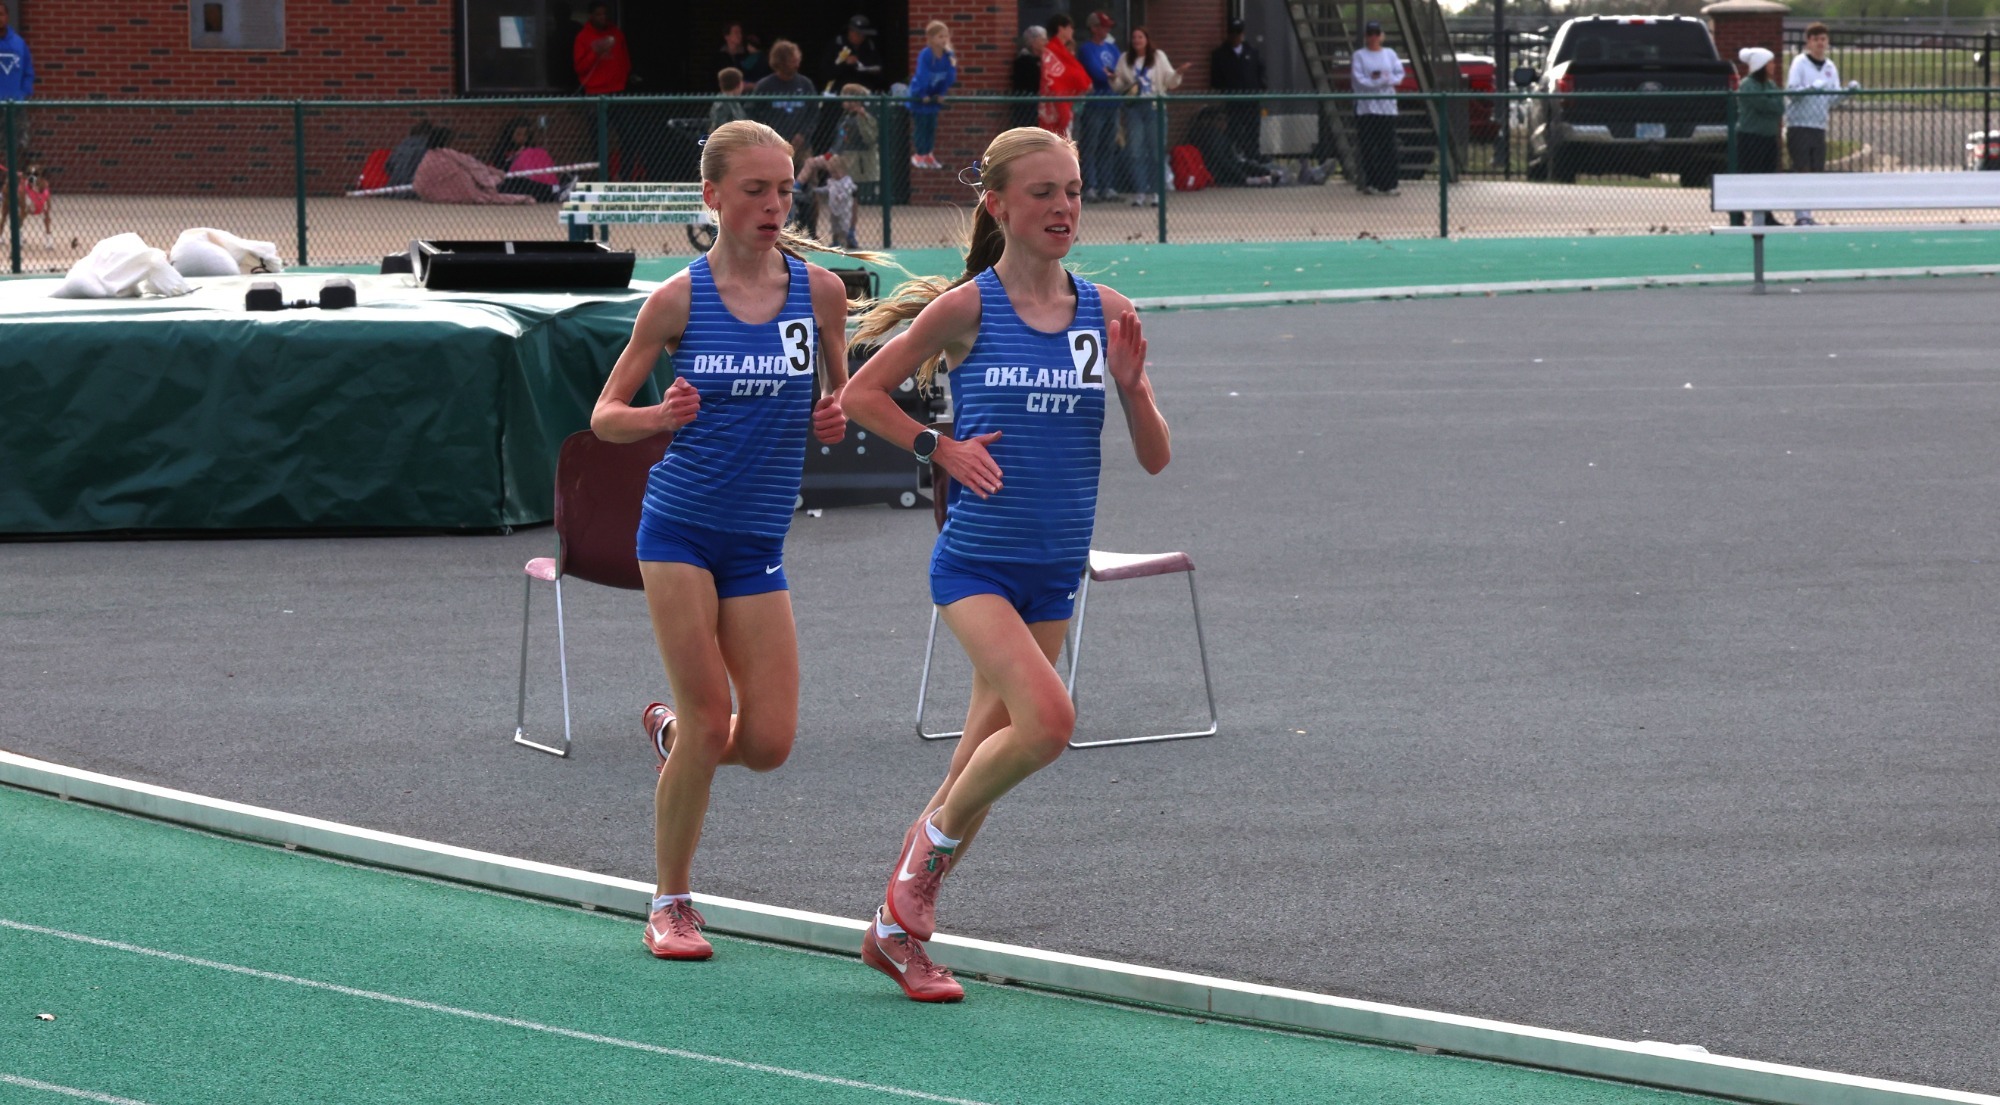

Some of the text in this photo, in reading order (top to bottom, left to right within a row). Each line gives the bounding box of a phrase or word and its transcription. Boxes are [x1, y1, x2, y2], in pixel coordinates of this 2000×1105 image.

[598, 194, 703, 202] OKLAHOMA BAPTIST UNIVERSIT
[604, 184, 703, 193] OKLAHOMA BAPTIST UNIVERS
[587, 213, 699, 223] OKLAHOMA BAPTIST UNIVERSITY
[591, 204, 703, 212] OKLAHOMA BAPTIST UNIVERSITY
[785, 322, 811, 371] 3
[693, 354, 788, 375] OKLAHO
[1074, 333, 1103, 384] 2
[731, 378, 787, 397] CITY
[984, 366, 1079, 389] OKLAHO
[1026, 392, 1081, 414] CITY
